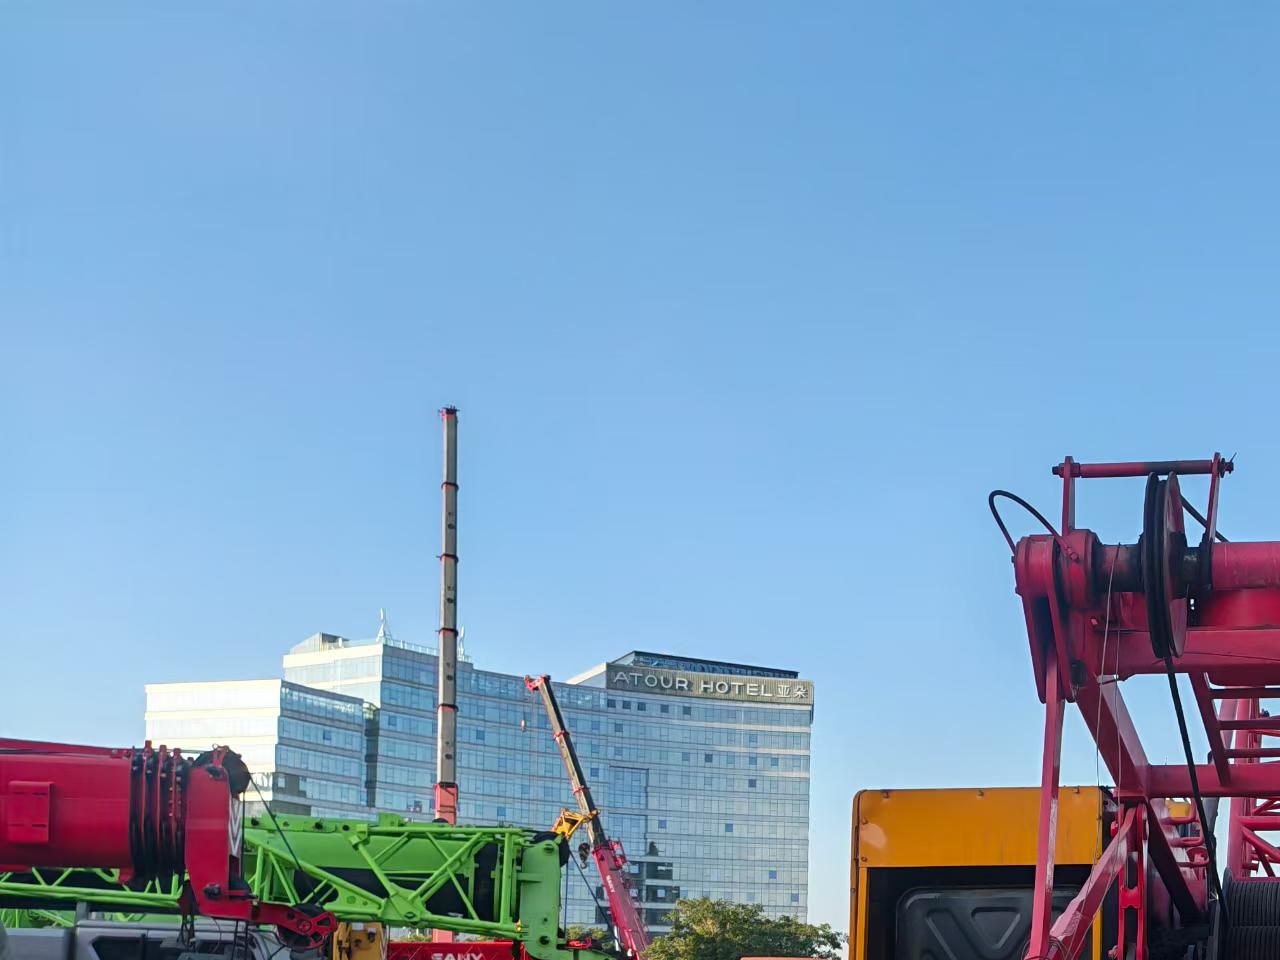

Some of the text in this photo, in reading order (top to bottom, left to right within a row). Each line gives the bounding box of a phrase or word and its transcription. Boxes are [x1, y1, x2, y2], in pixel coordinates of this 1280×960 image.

[613, 671, 773, 697] ATOUR HOTEL
[777, 684, 808, 699] 亚朵
